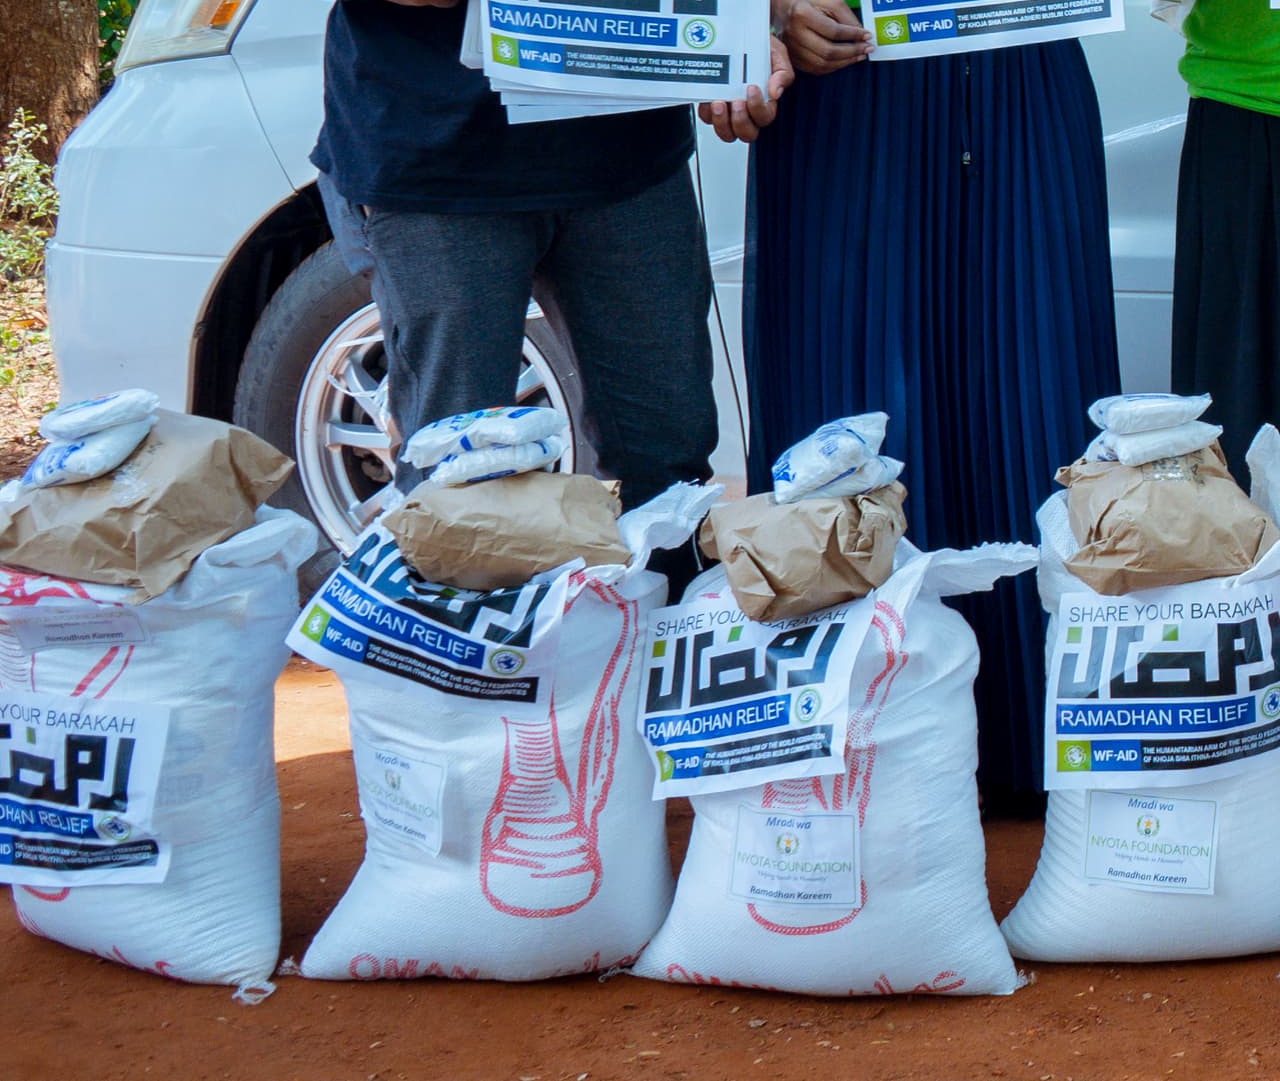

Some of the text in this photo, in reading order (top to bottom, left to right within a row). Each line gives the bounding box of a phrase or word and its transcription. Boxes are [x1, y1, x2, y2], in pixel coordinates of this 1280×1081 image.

[492, 7, 672, 39] RAMADHAN RELIEF
[910, 18, 953, 33] WF-AID
[520, 48, 562, 64] WF-AID
[327, 579, 478, 662] RAMADHAN RELIEF
[1068, 596, 1274, 623] SHARE YOUR BARAKAH
[655, 610, 706, 638] SHARE
[326, 626, 364, 652] WF-AID
[46, 711, 135, 733] BARAKAH
[646, 701, 786, 741] RAMADHAN RELIEF
[1060, 702, 1248, 728] RAMADHAN RELIEF
[1094, 750, 1138, 762] WF-AID
[38, 810, 88, 834] RELIEF
[349, 952, 480, 981] OMAN
